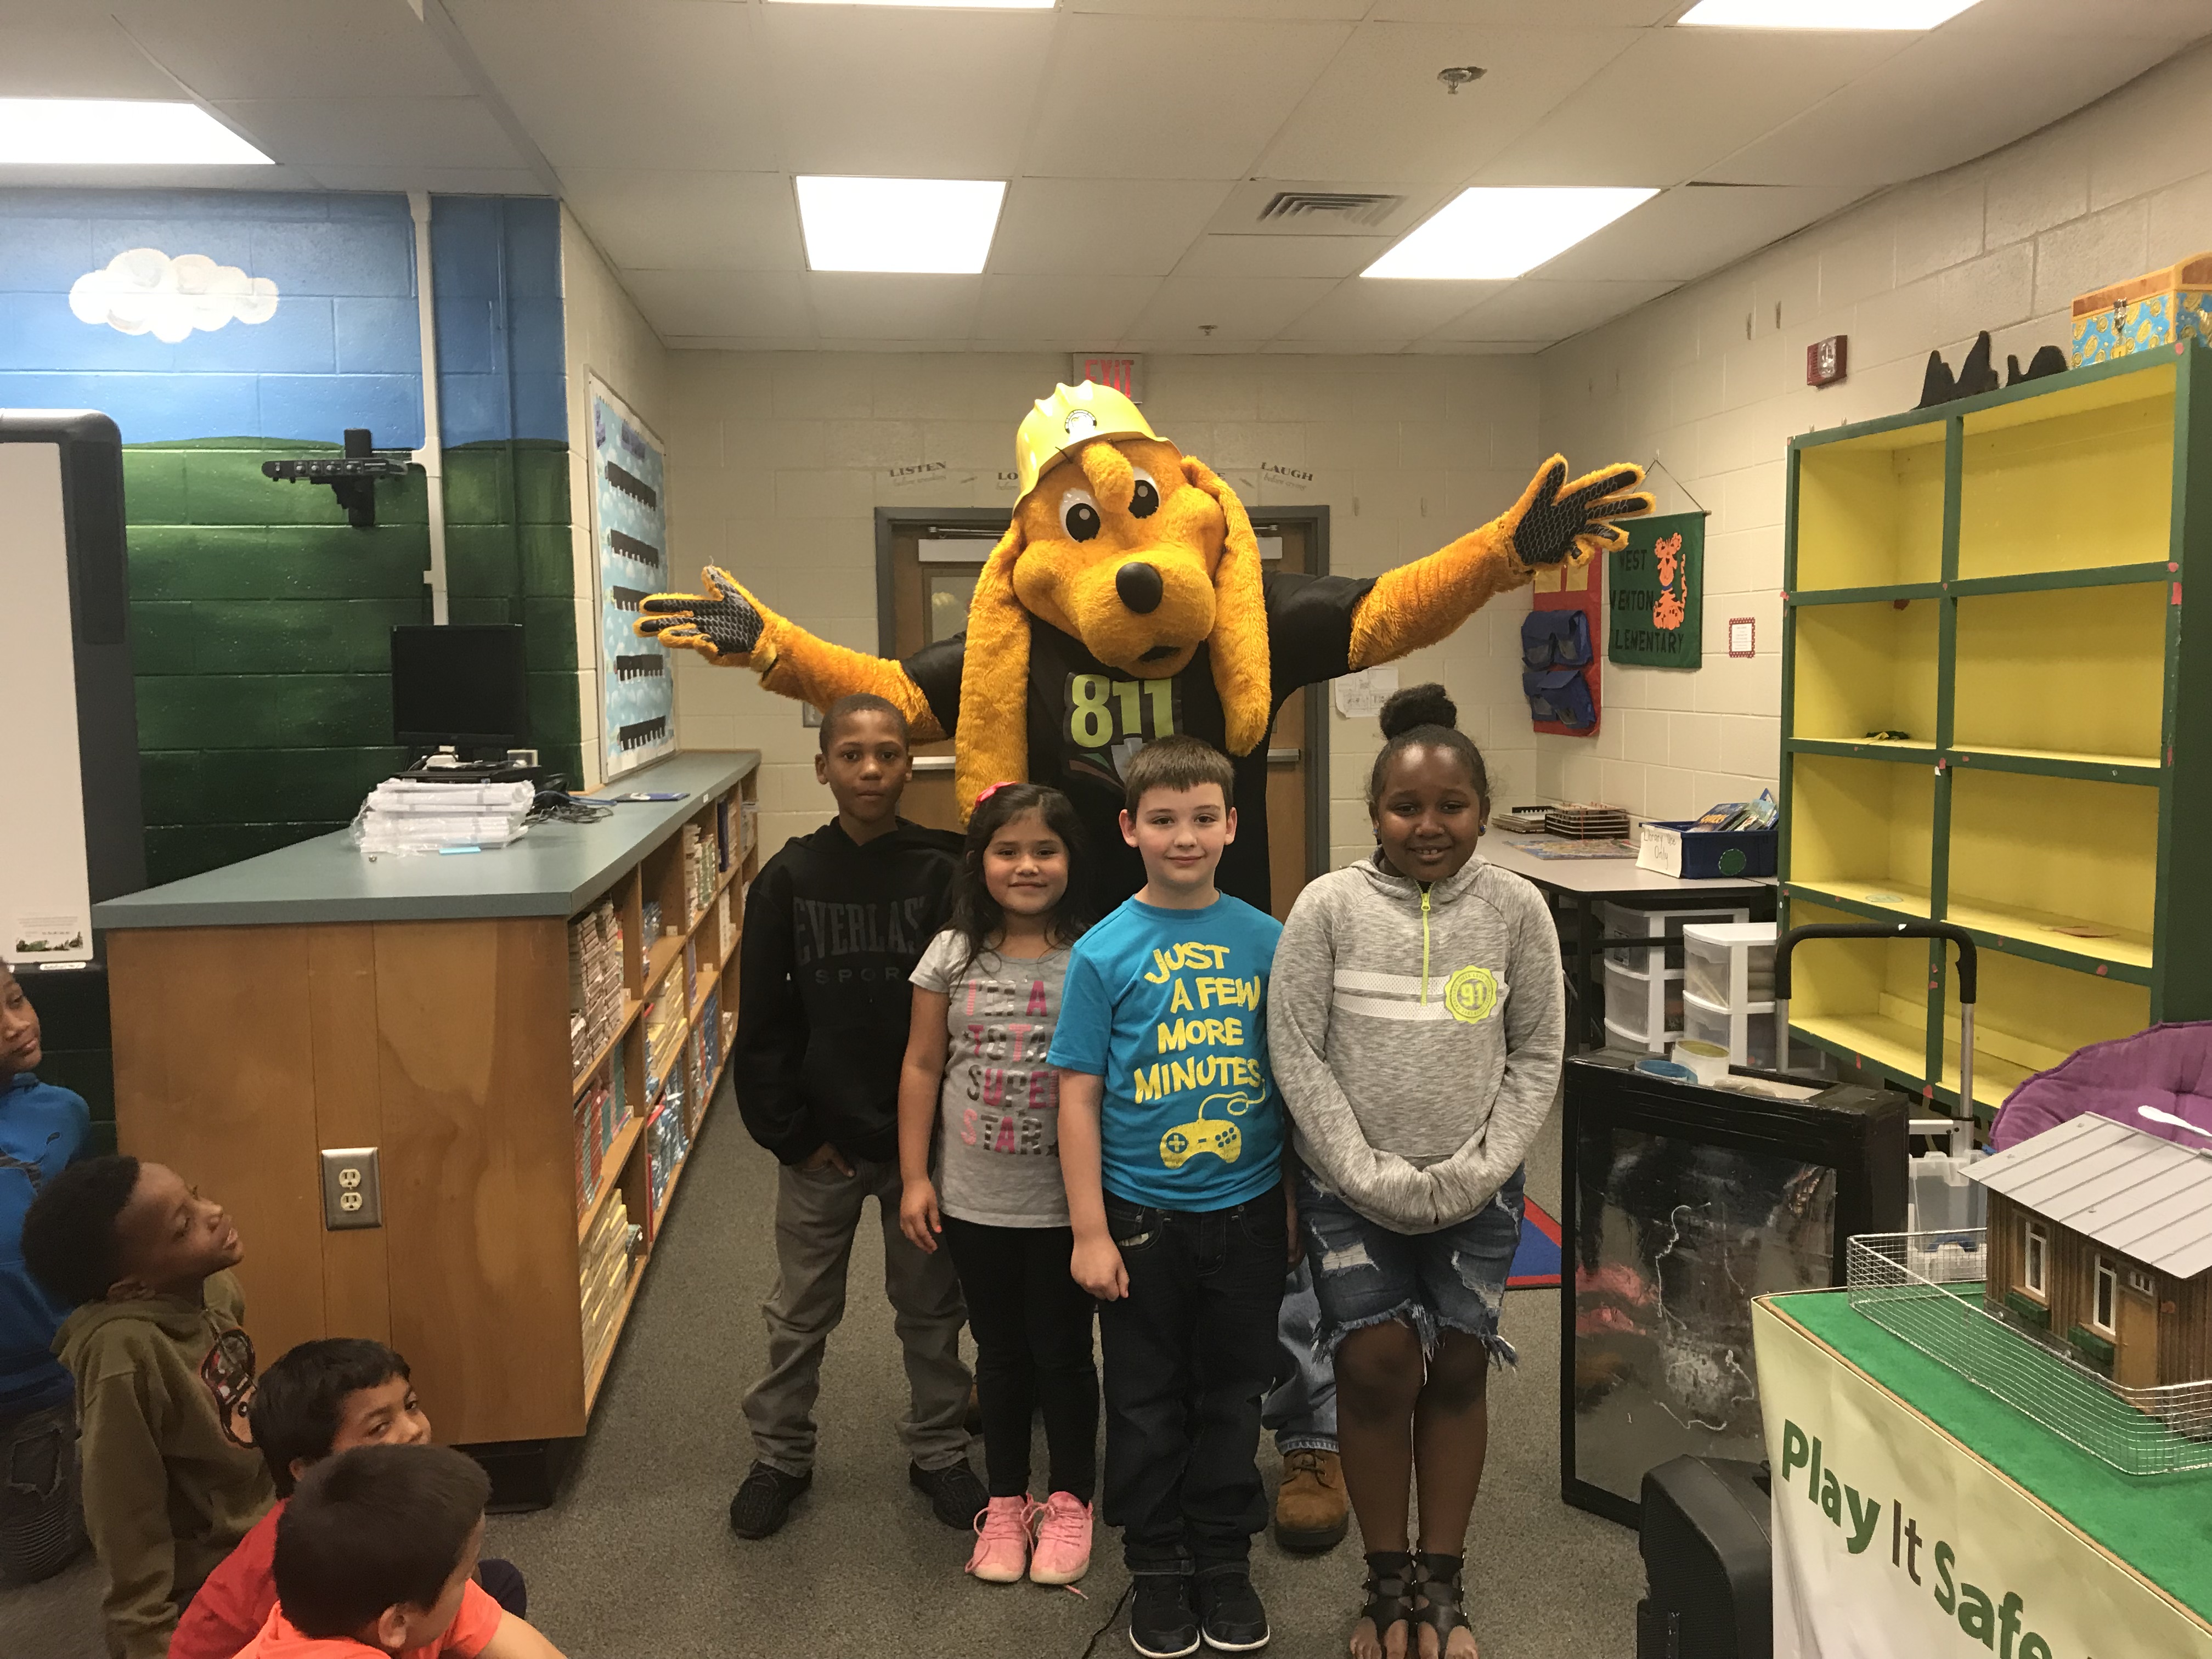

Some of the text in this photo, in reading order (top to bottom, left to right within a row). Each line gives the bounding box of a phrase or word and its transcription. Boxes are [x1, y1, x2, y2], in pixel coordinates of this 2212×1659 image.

[1085, 359, 1135, 399] EXIT
[889, 461, 947, 478] LISTEN
[997, 471, 1019, 480] LO
[1260, 461, 1313, 482] LAUGH
[1614, 628, 1684, 654] LEMENTARY
[1070, 674, 1175, 748] 811
[1644, 828, 1677, 849] Library Use
[1654, 845, 1668, 870] Only
[793, 895, 927, 966] EVERLAS
[814, 966, 900, 985] SPOR
[1144, 941, 1230, 984] JUST
[1025, 980, 1047, 1017] A
[1170, 975, 1261, 1014] A FEW
[1460, 982, 1485, 1007] 91
[967, 1023, 1047, 1063] TOTA
[1157, 1017, 1244, 1054] MORE
[1133, 1054, 1261, 1104] MINUTES
[961, 1108, 1042, 1155] STAR
[1781, 1418, 1882, 1555] Play
[1892, 1498, 1923, 1587] It
